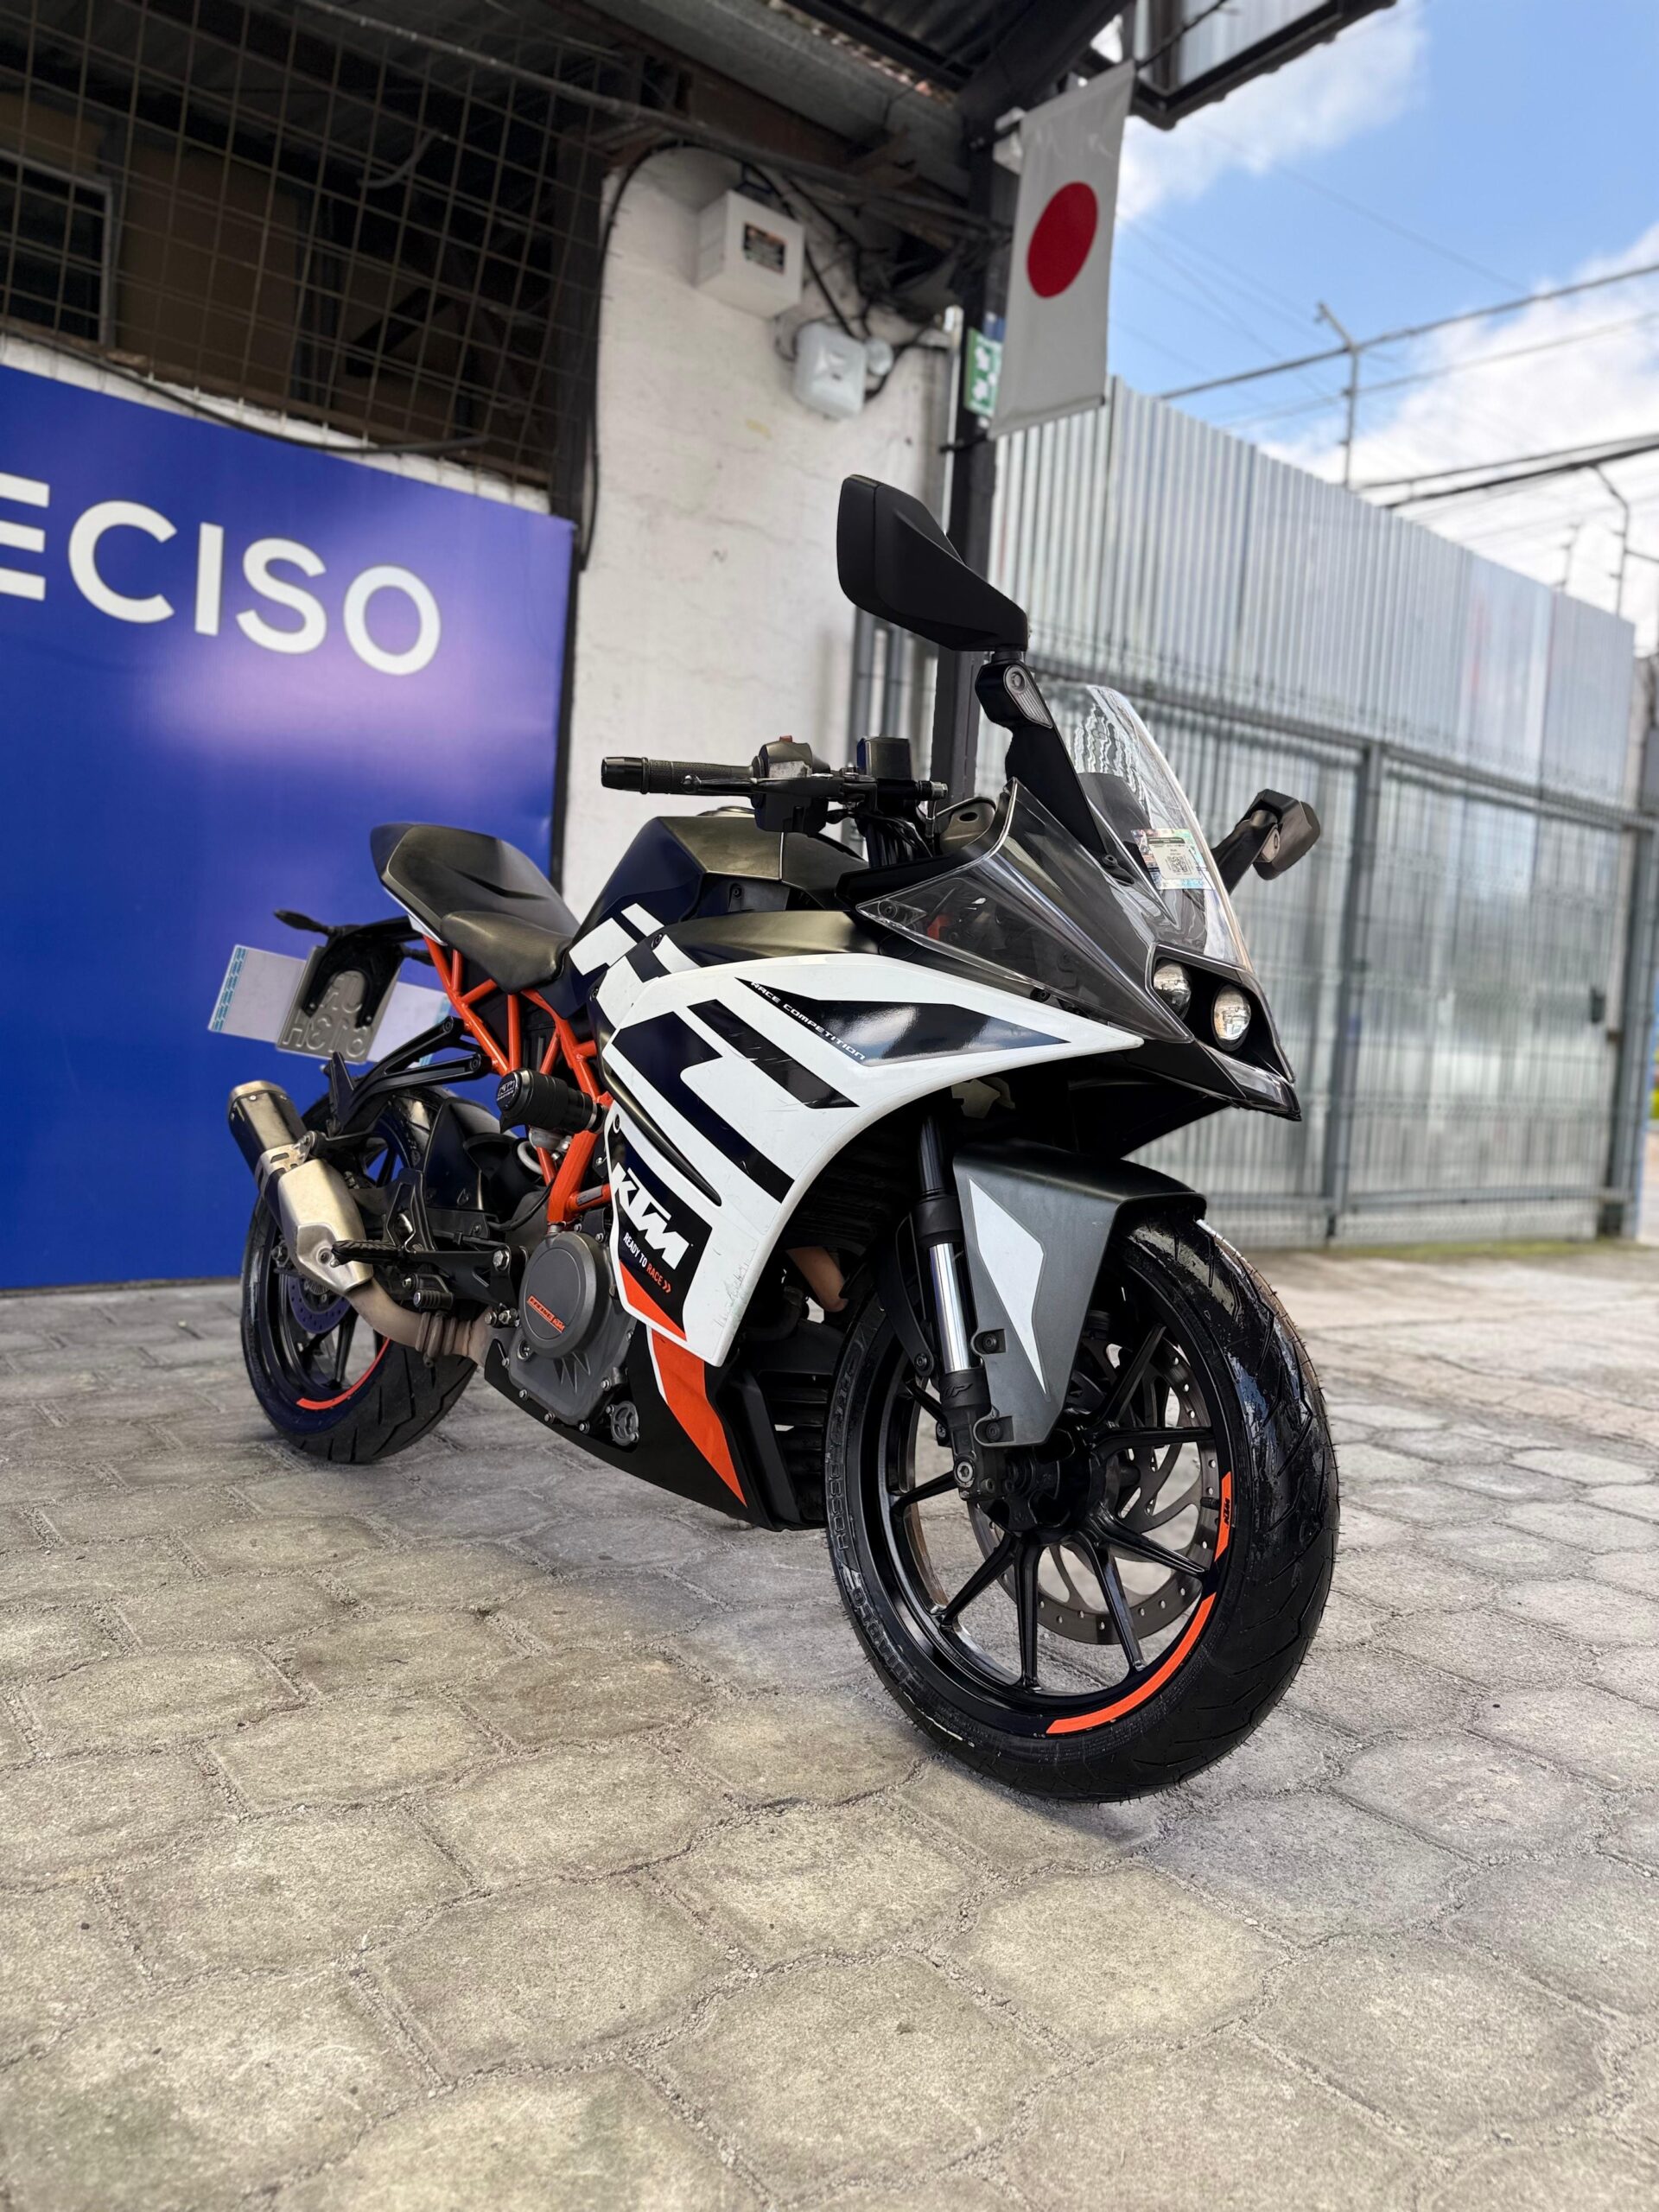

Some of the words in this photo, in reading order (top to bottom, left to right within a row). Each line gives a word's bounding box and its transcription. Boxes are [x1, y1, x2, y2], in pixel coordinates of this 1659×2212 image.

[0, 472, 442, 676] ECISO
[751, 982, 782, 1004] RACE
[783, 1003, 866, 1061] COMPETITION
[612, 1162, 690, 1270] KTM
[623, 1232, 640, 1259] READY
[639, 1254, 648, 1268] TO
[646, 1262, 664, 1287] RACE
[830, 1463, 849, 1550] ROSSO
